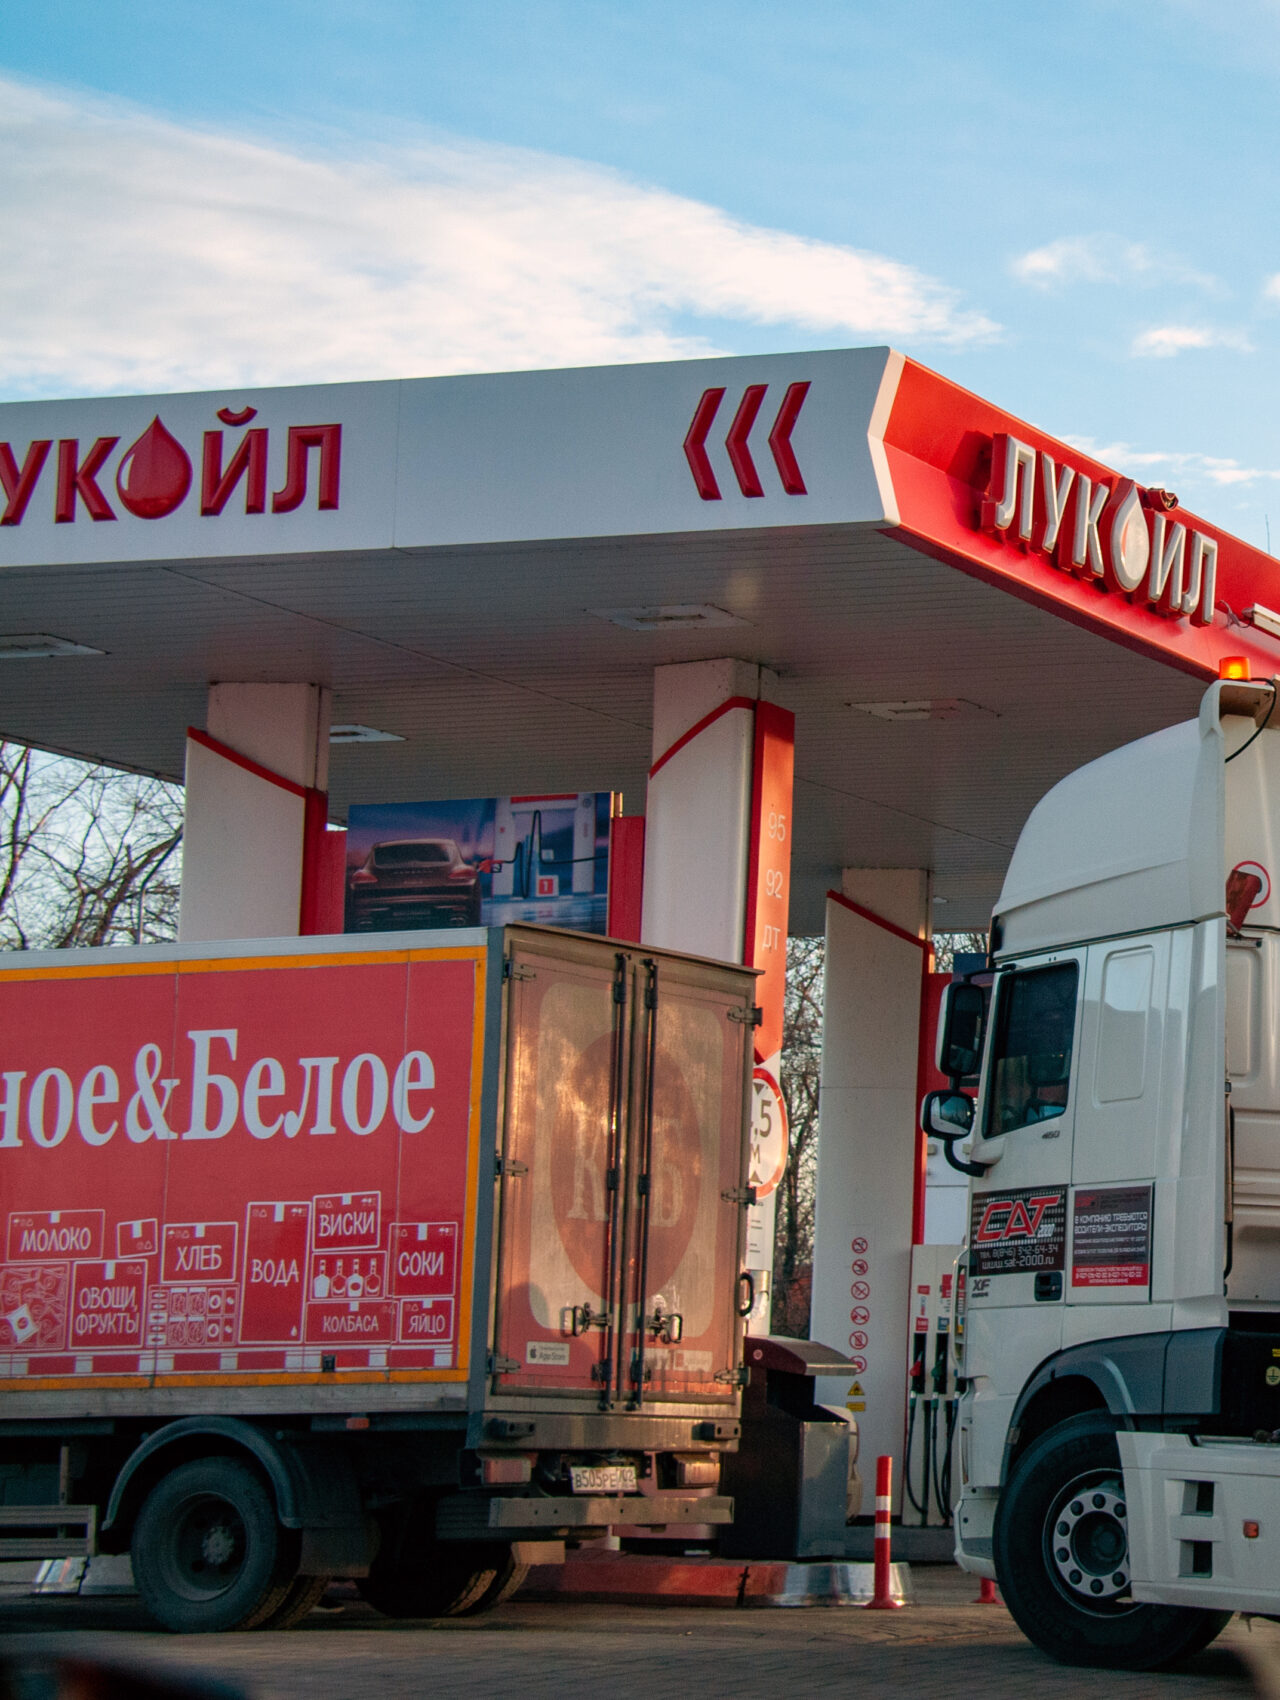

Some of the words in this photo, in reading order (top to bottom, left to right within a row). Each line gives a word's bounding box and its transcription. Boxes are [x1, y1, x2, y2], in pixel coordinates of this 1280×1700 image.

[990, 433, 1218, 625] ЛУКОЙЛ
[768, 812, 786, 842] 95
[766, 869, 783, 899] 92
[762, 925, 781, 953] ДТ
[318, 1211, 375, 1237] ВИСКИ
[20, 1227, 91, 1252] МОЛОКО
[175, 1244, 222, 1271] ХЛЕБ
[398, 1251, 444, 1276] СОКИ
[251, 1258, 299, 1287] ВОДА
[972, 1278, 990, 1292] XF
[79, 1286, 138, 1312] ОВОЩИ,
[75, 1312, 140, 1336] ФРУКТЫ
[322, 1315, 380, 1333] КОЛБАСА
[408, 1313, 446, 1335] ЯЙЦО
